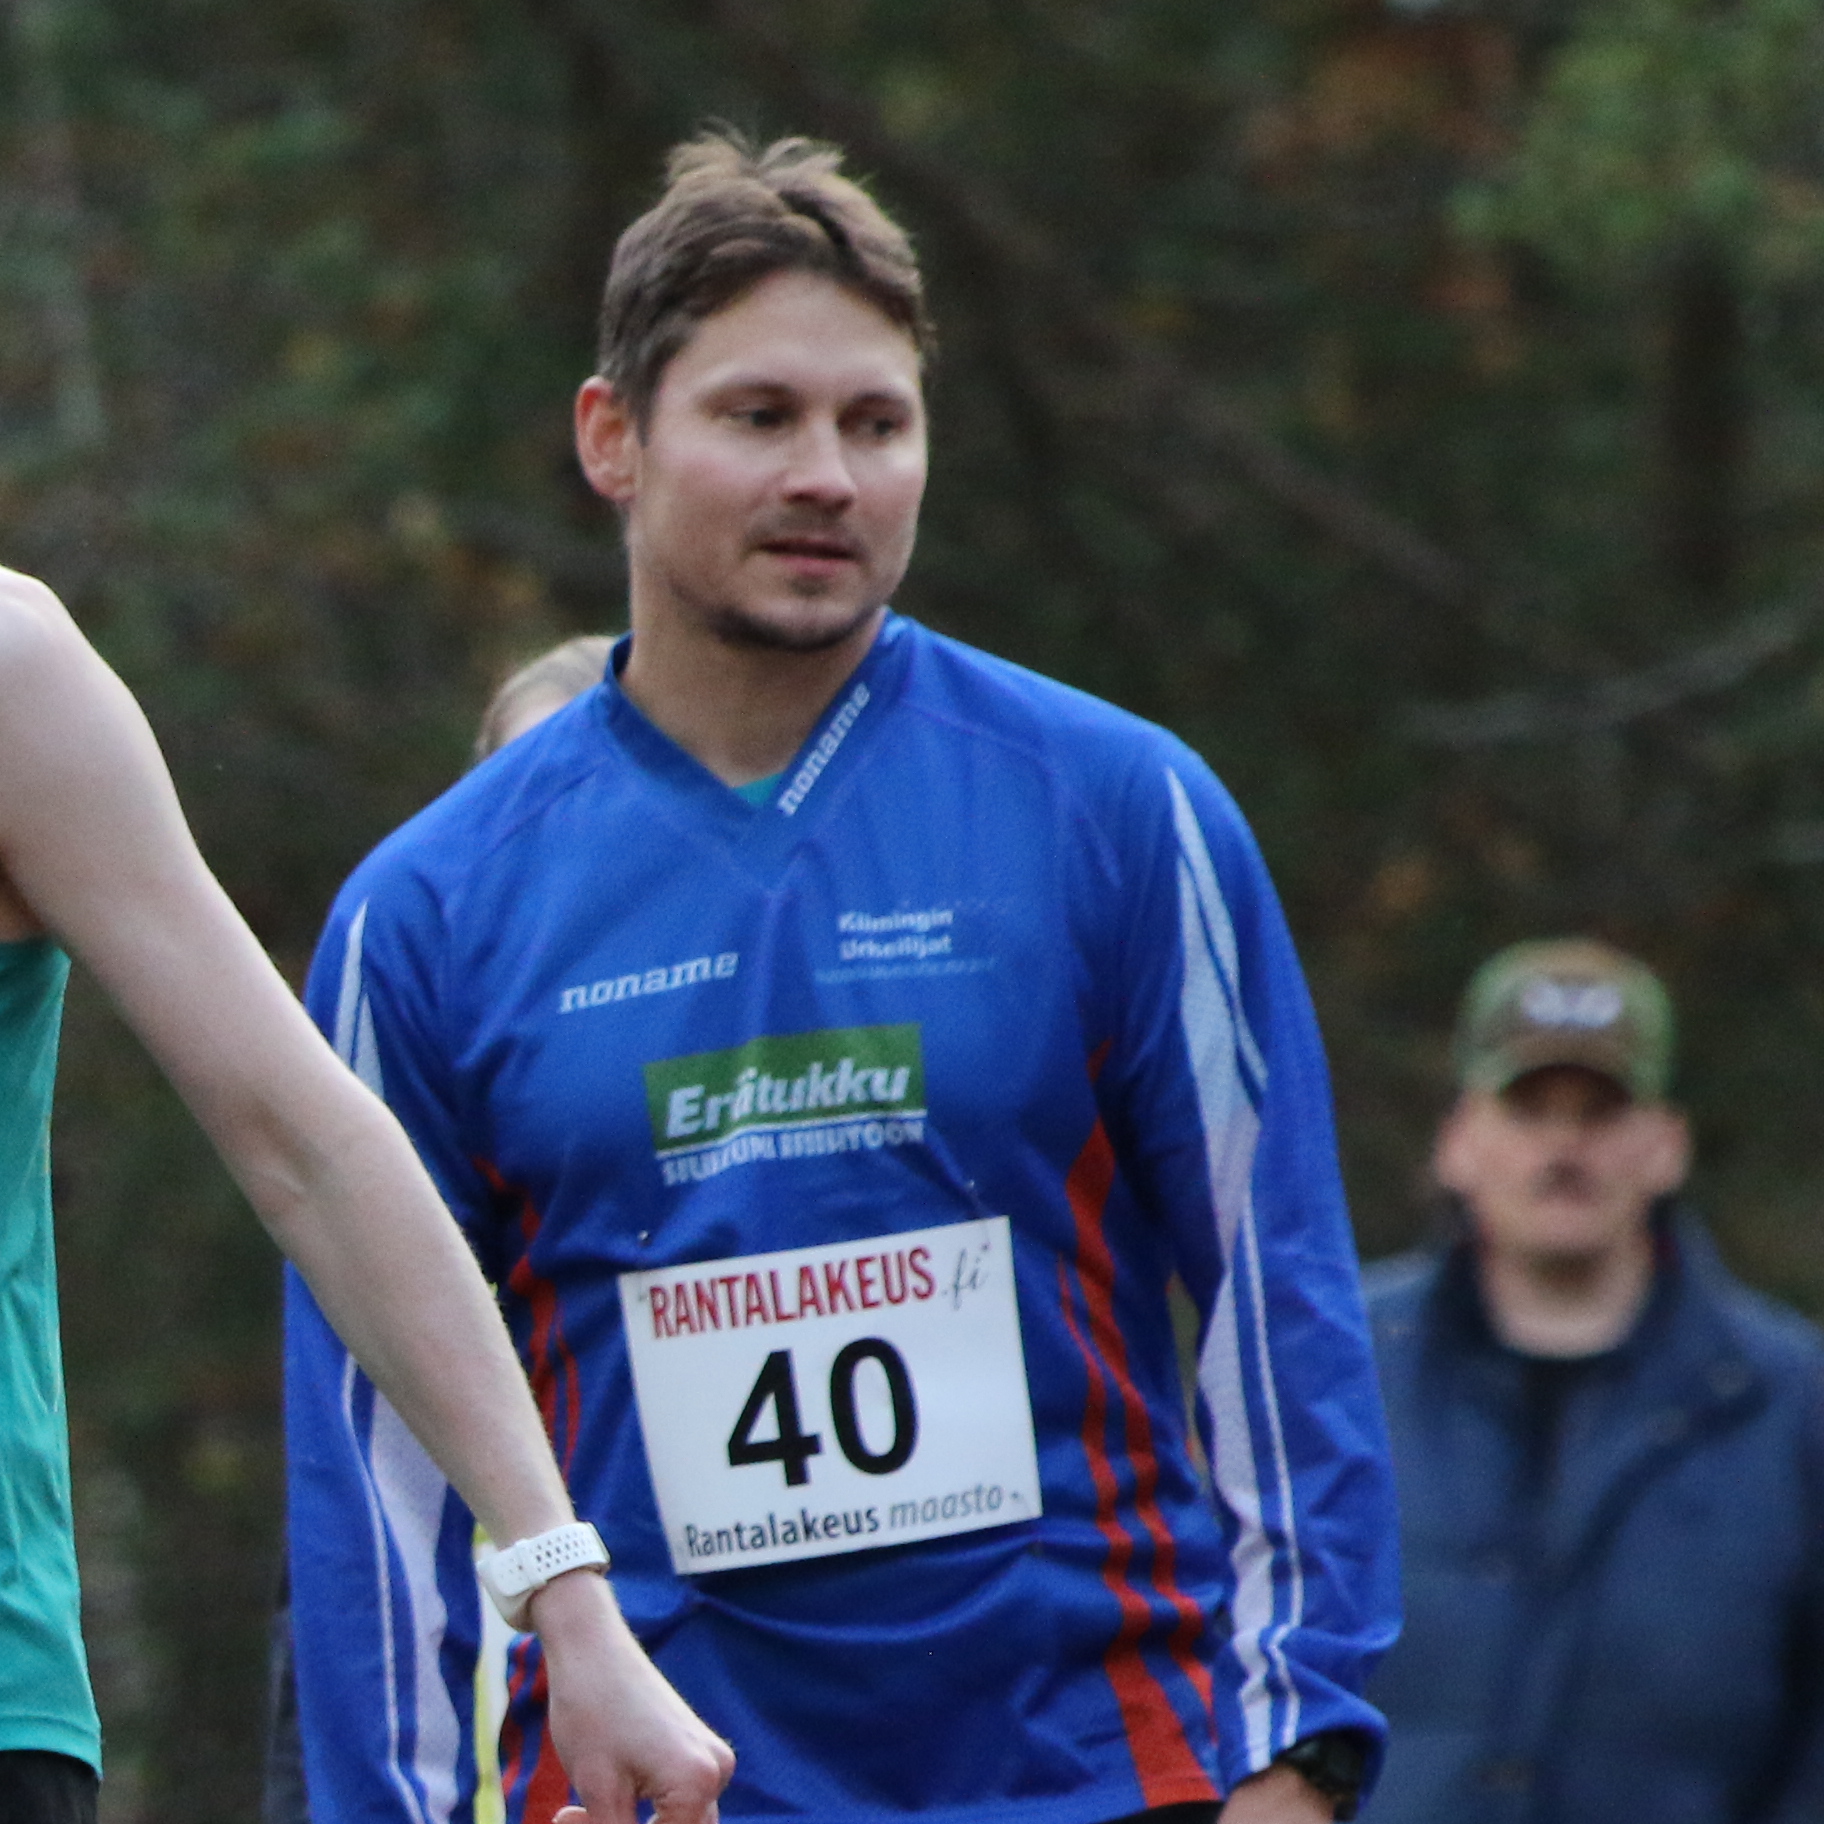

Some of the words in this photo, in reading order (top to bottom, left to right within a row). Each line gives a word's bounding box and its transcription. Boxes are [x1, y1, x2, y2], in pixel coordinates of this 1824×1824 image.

[777, 682, 870, 817] noname
[557, 952, 740, 1014] noname
[649, 1247, 937, 1339] RANTALAKEUS
[728, 1337, 920, 1488] 40
[685, 1507, 880, 1559] Rantalakeus
[888, 1483, 1004, 1530] maasto
